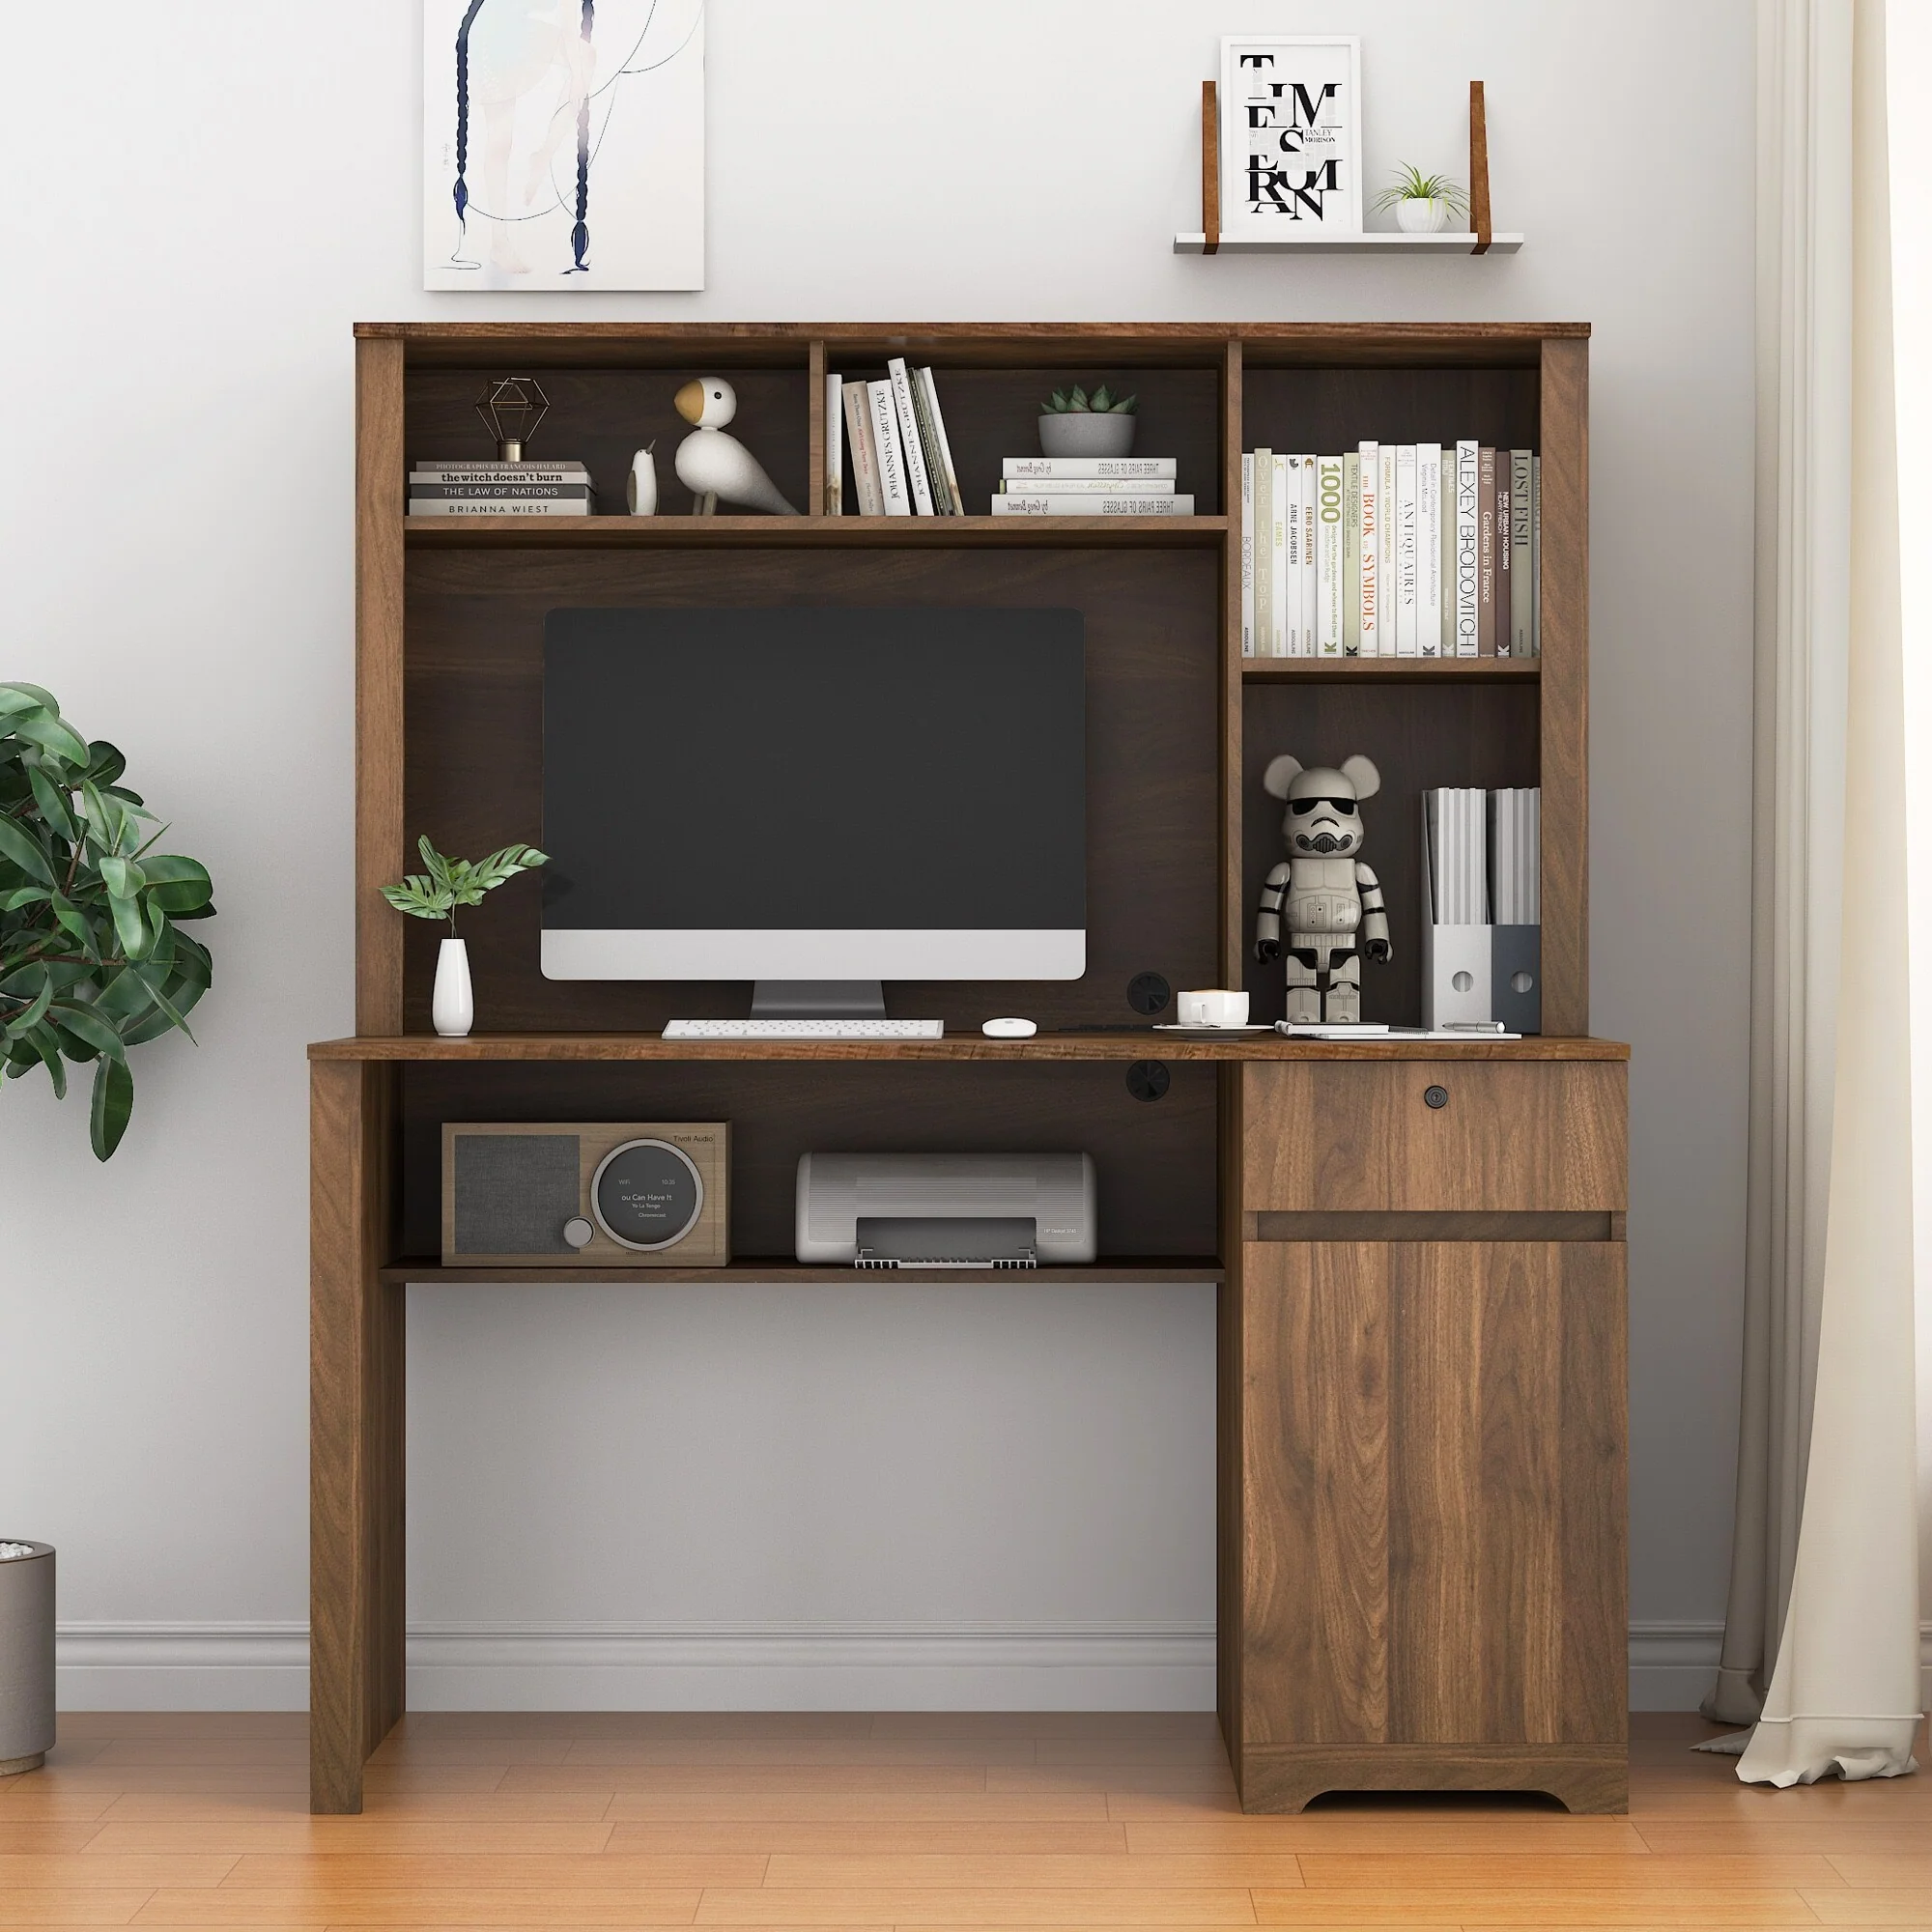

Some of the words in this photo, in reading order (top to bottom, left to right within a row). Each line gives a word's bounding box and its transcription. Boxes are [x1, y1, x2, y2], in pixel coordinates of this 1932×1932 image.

[441, 473, 460, 482] the
[462, 473, 492, 482] witch
[536, 473, 562, 482] burn
[884, 441, 900, 499] JOHANNES
[907, 430, 925, 497] JOHANNES
[1460, 446, 1475, 521] ALEXEY
[1514, 456, 1528, 501] LOST
[1321, 464, 1341, 524] 1000
[1363, 494, 1375, 537] BOOK
[1402, 500, 1414, 605] ANTIQUAIRES
[1483, 512, 1492, 554] Gardens
[1514, 507, 1528, 546] FISH
[1242, 536, 1251, 589] BORDEAUX
[1460, 526, 1475, 646] BRODOVITCH
[1483, 555, 1492, 566] in
[1483, 568, 1492, 604] France
[1363, 554, 1375, 631] SYMBOLS
